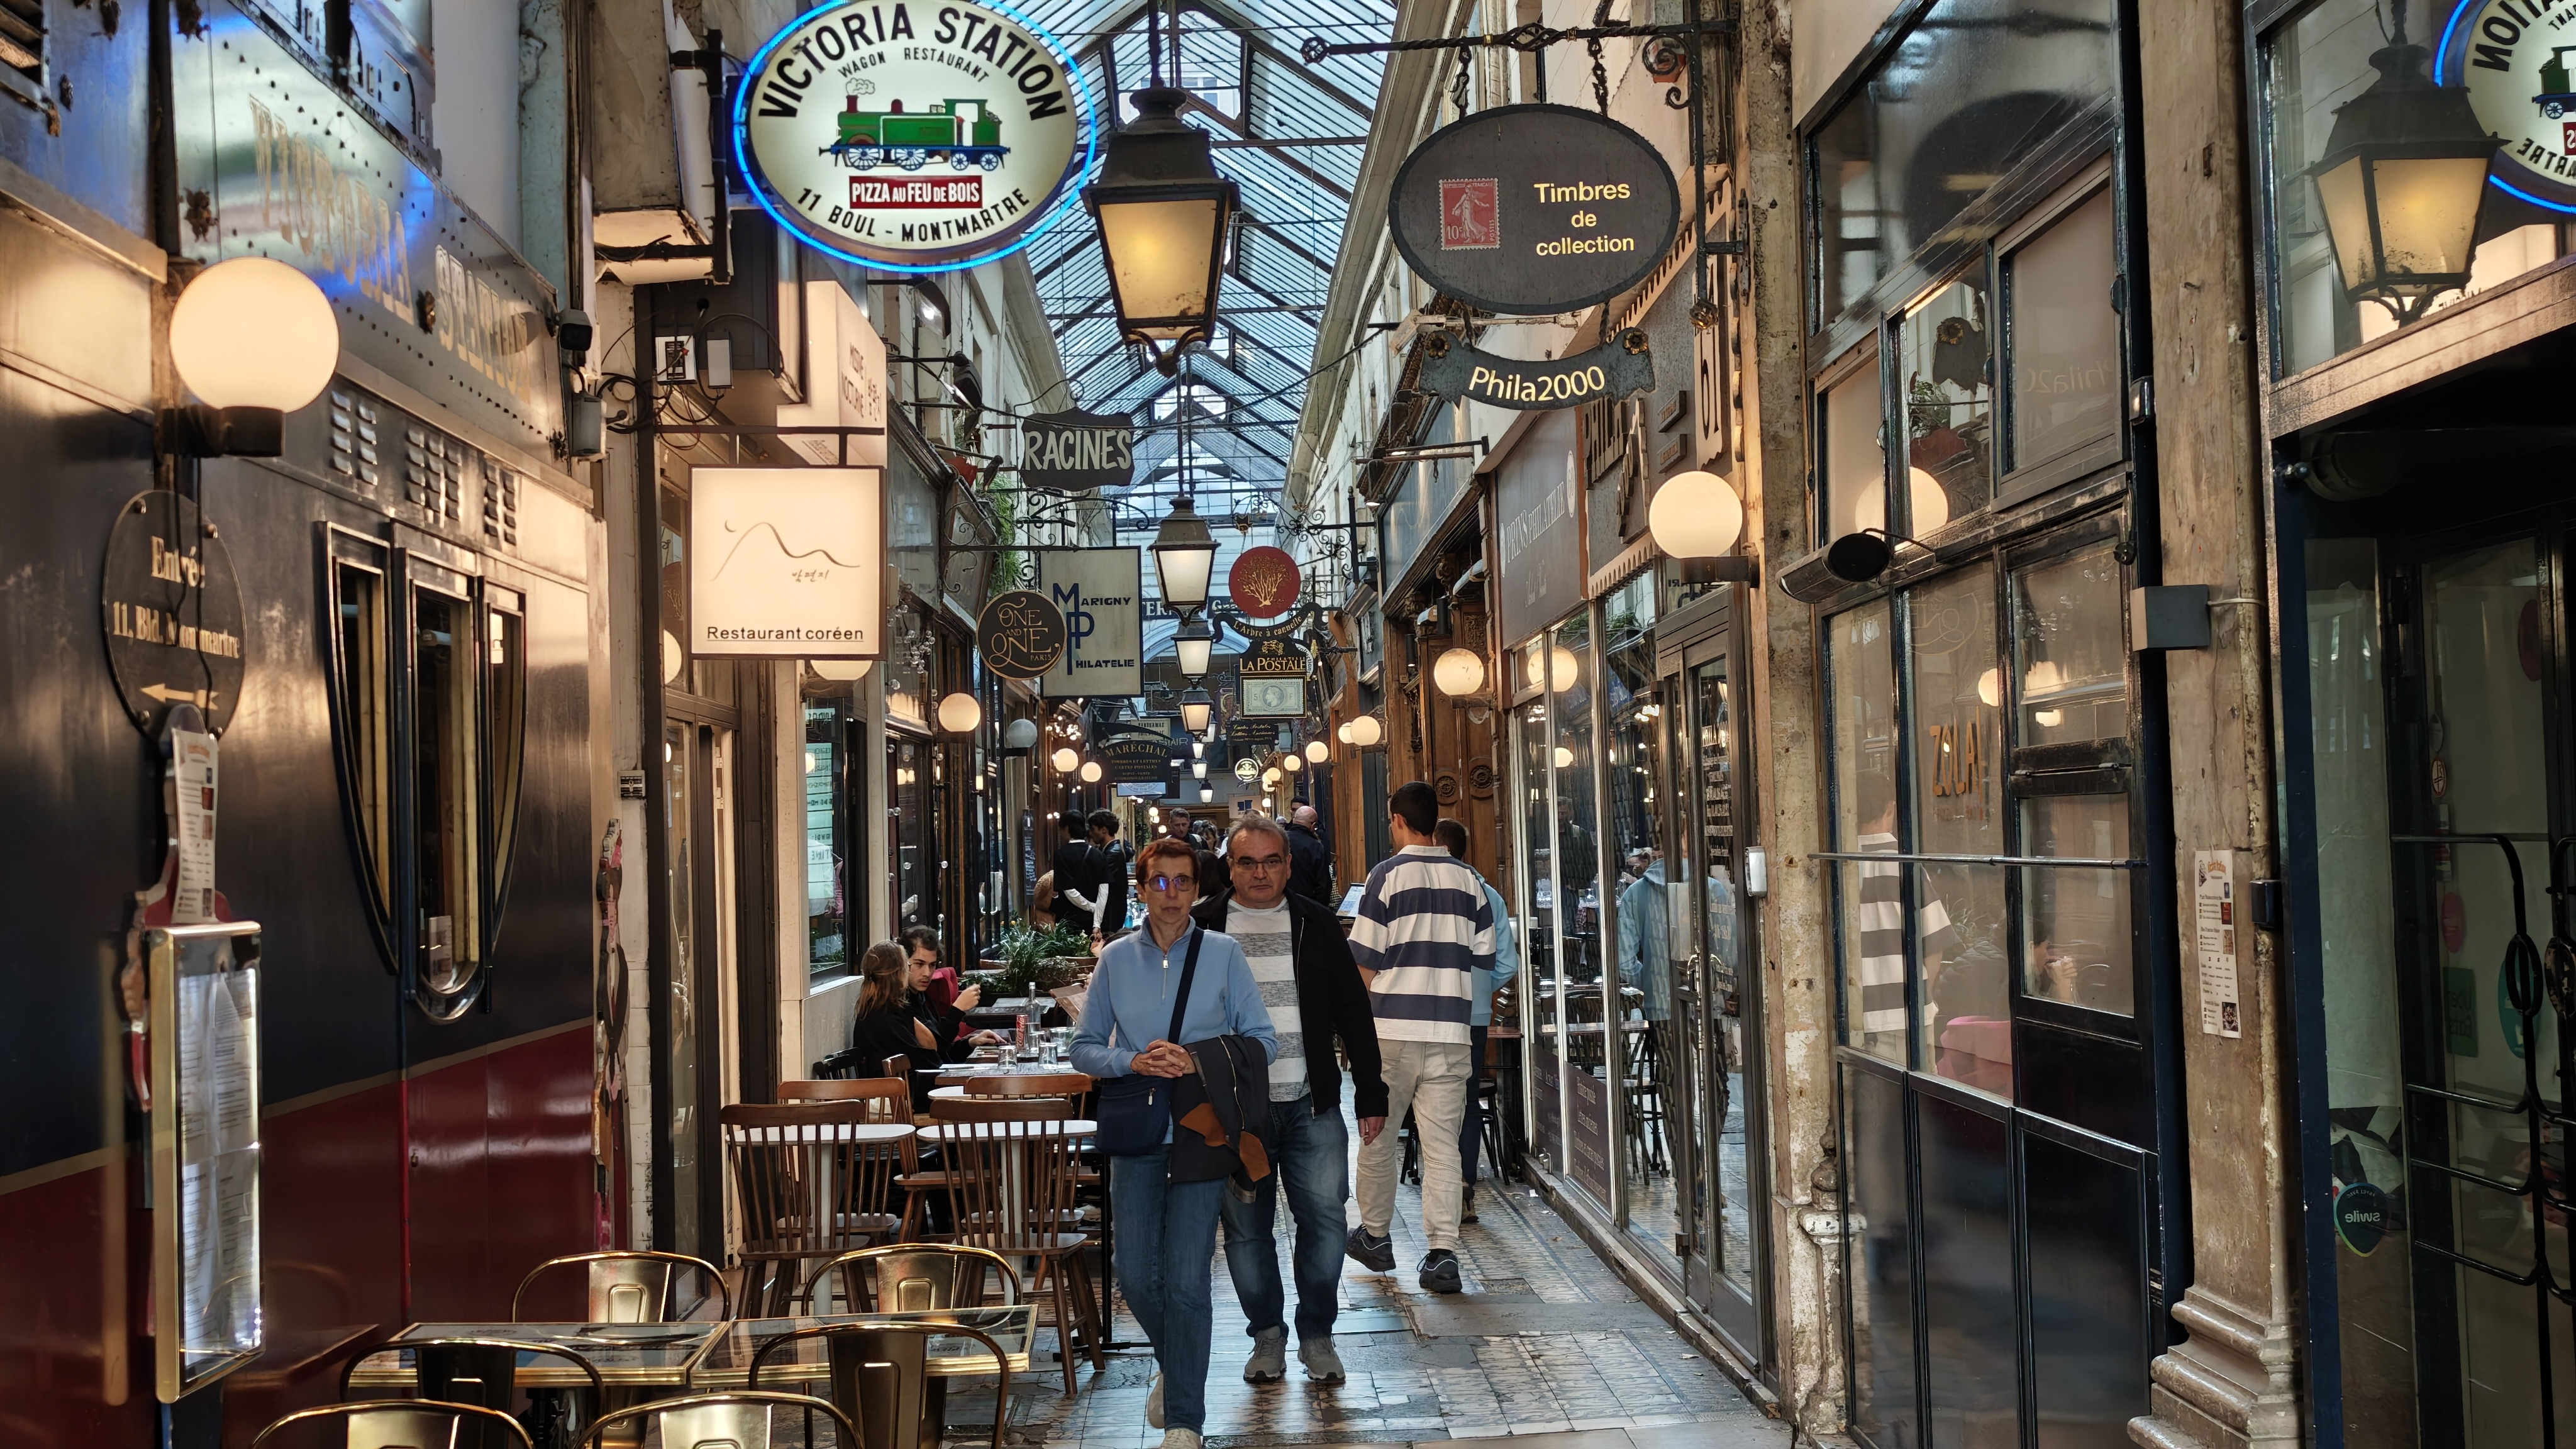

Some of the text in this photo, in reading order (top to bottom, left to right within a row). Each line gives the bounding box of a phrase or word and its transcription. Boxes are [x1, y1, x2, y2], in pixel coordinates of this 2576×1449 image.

[758, 2, 1067, 121] VICTORIA STATION
[838, 47, 989, 82] WAGON RESTAURANT
[852, 182, 979, 203] PIZZA AU FEU DE BOIS
[1534, 181, 1631, 204] Timbres
[797, 187, 823, 211] 11
[828, 204, 876, 237] BOUL
[901, 187, 1031, 243] MONTMARTRE
[1571, 210, 1597, 228] de
[1536, 235, 1635, 256] collection
[1468, 365, 1606, 402] Phila2000
[1025, 430, 1131, 470] RACINES
[1528, 481, 1565, 545] PHILATELIE
[998, 601, 1042, 626] ONE
[706, 626, 864, 641] Restaurant coréen
[1233, 615, 1302, 637] L'Arbre à cannelle
[990, 628, 1057, 665] ONE
[1240, 657, 1306, 671] LA POSTALE
[1104, 741, 1168, 758] MARÉCHAL
